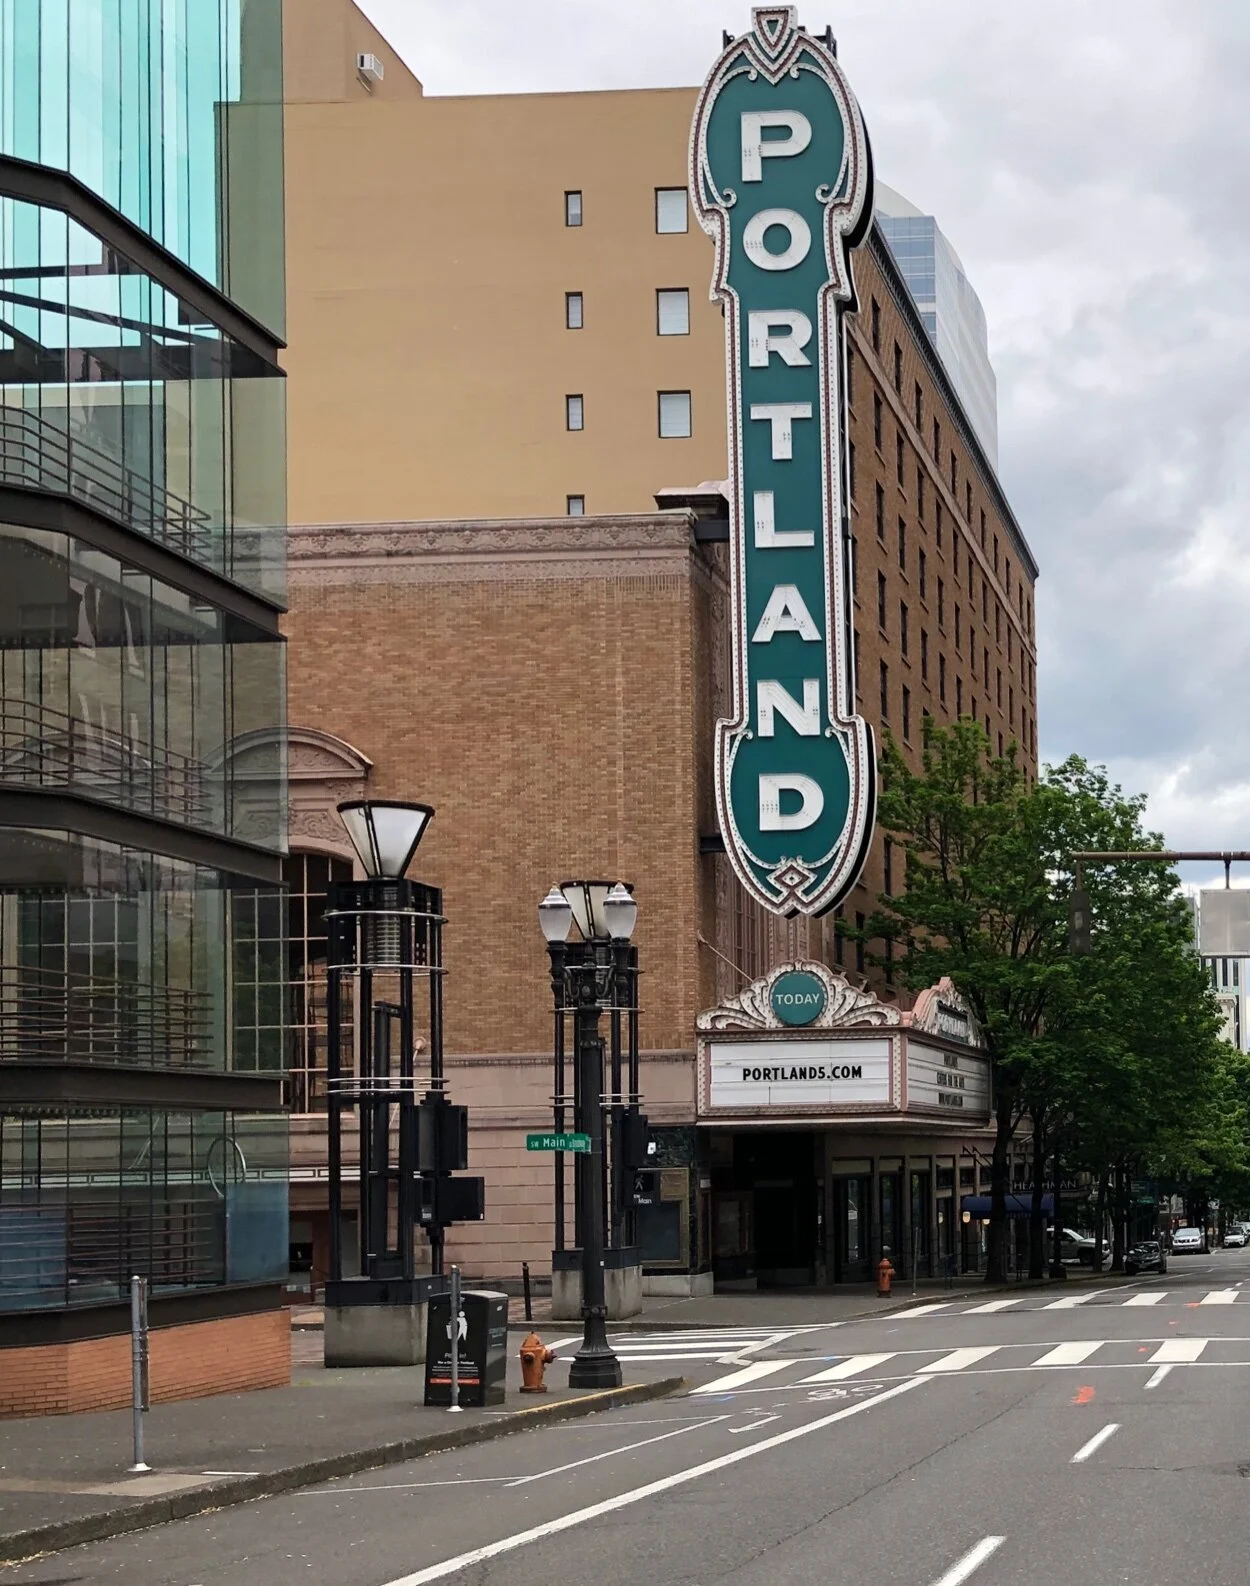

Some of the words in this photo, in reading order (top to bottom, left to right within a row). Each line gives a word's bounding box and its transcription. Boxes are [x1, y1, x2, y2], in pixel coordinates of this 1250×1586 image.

[740, 110, 824, 832] PORTLAND
[775, 993, 820, 1006] TODAY
[543, 1137, 566, 1148] Main
[1013, 1180, 1077, 1190] HEAHMAN
